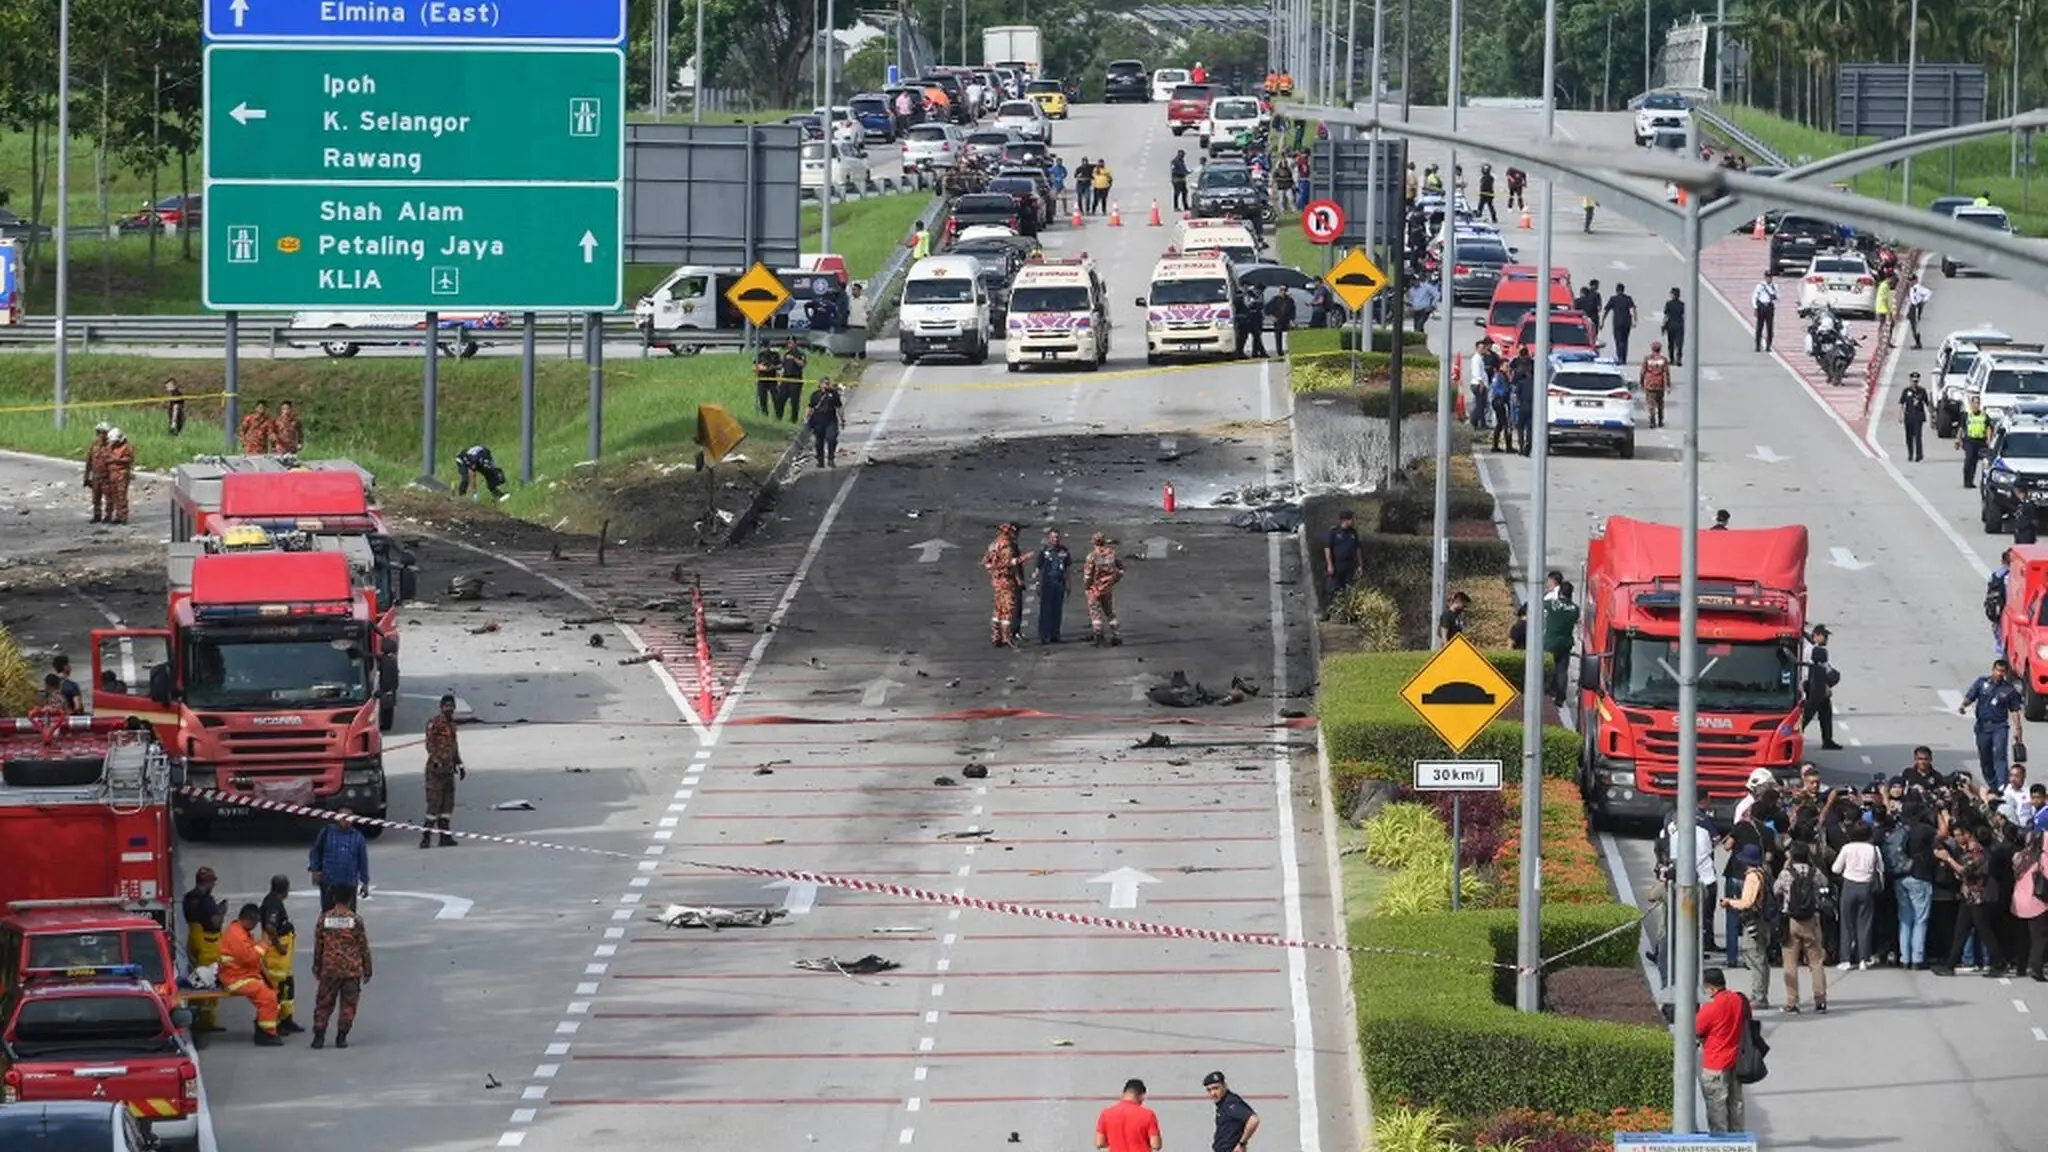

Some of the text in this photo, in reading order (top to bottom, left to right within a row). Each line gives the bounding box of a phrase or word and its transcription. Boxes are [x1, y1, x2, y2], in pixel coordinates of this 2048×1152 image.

[320, 1, 500, 27] Elmina (East)
[323, 73, 376, 98] Ipoh
[323, 111, 470, 137] K. Selangor
[323, 147, 422, 174] Rawang
[319, 200, 464, 222] Shah Alam
[318, 234, 505, 261] Petaling Jaya
[318, 269, 383, 290] KLIA
[1671, 715, 1733, 729] SANIA
